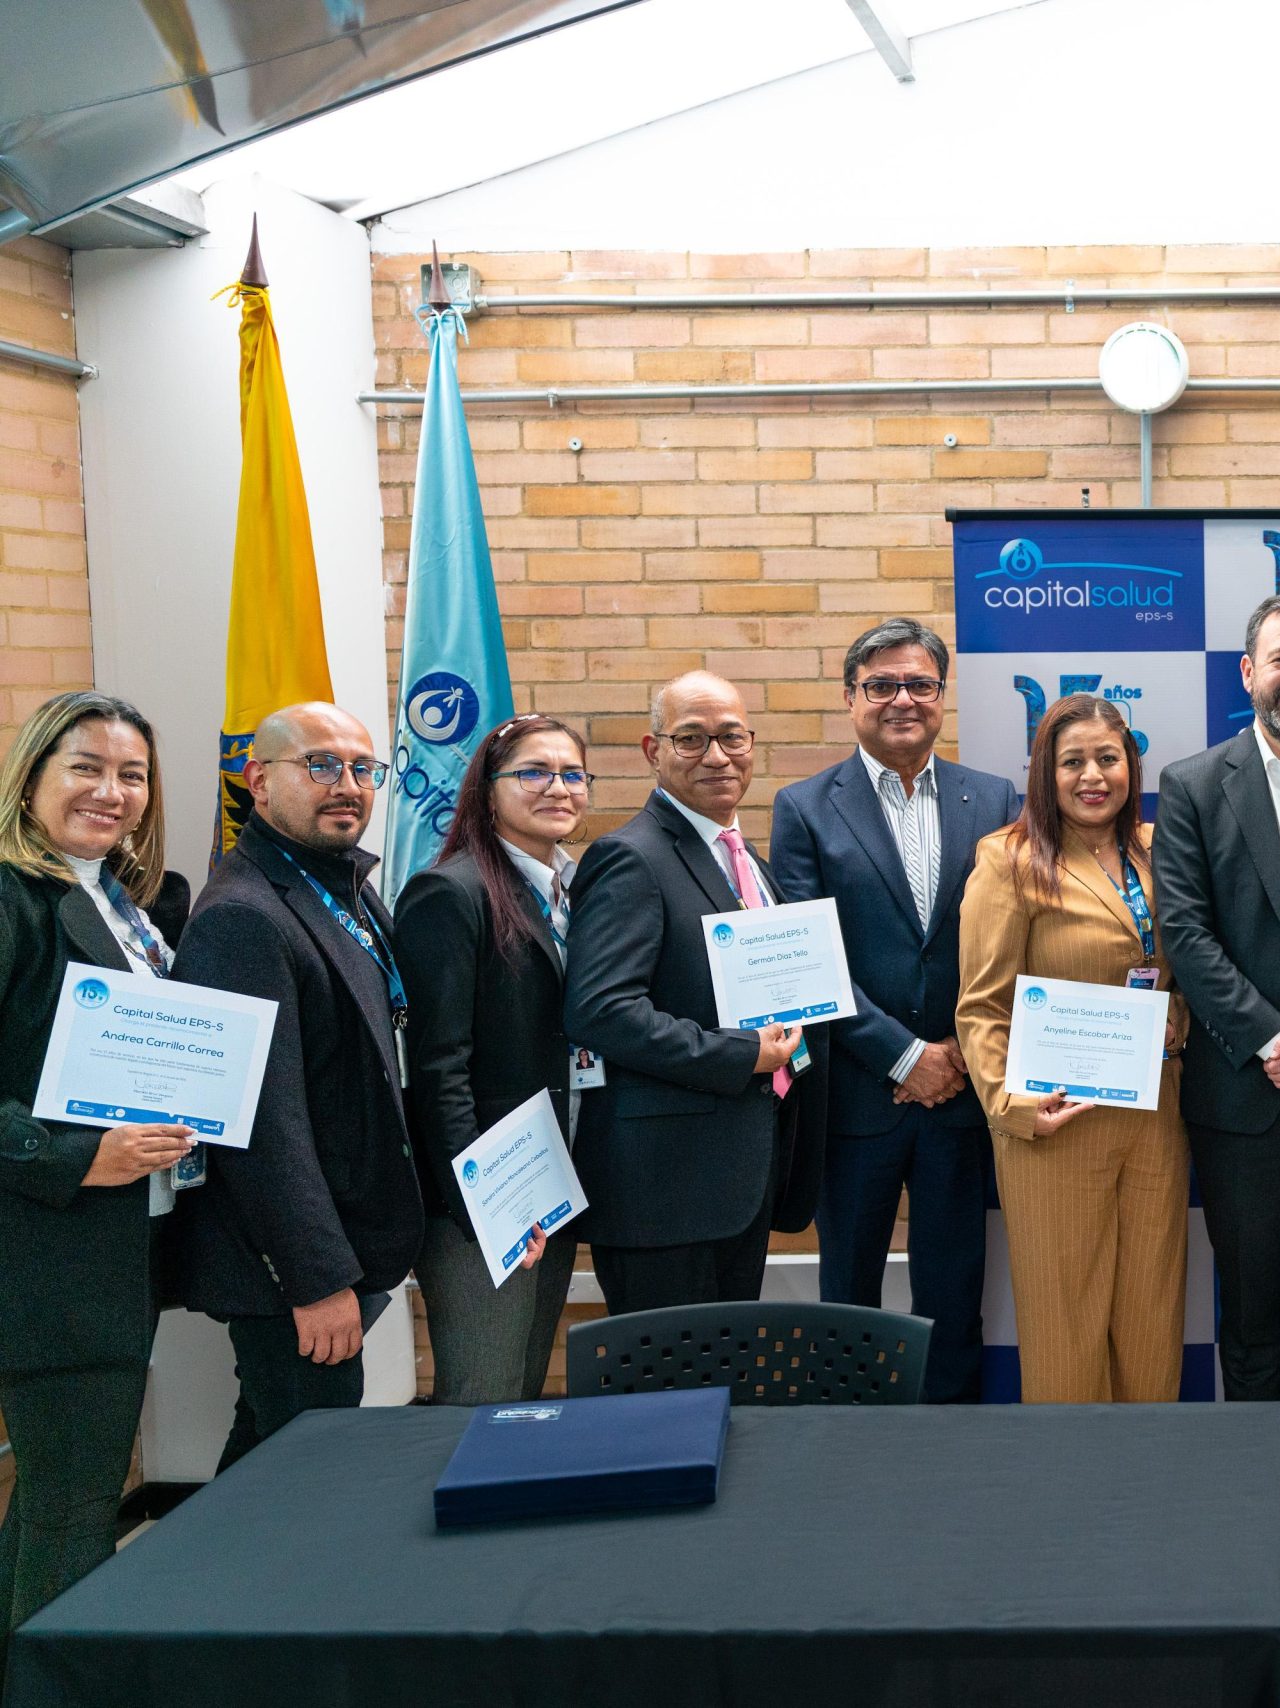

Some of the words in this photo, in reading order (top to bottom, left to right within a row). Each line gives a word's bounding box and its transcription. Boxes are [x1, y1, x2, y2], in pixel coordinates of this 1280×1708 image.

[984, 580, 1174, 614] capitalsalud
[1135, 612, 1174, 623] eps-s
[1104, 685, 1142, 699] años
[740, 935, 764, 945] Capital
[765, 931, 785, 941] Salud
[787, 928, 809, 938] EPS-S
[113, 1005, 154, 1020] Capital
[156, 1012, 187, 1025] Salud
[189, 1017, 224, 1032] EPS-S
[1050, 1005, 1079, 1017] Capital
[1080, 1008, 1103, 1018] Salud
[1104, 1010, 1130, 1021] EPS-S
[1079, 1029, 1111, 1039] Escobar
[101, 1030, 143, 1045] Andrea
[146, 1037, 186, 1051] Carrillo
[188, 1044, 224, 1058] Correa
